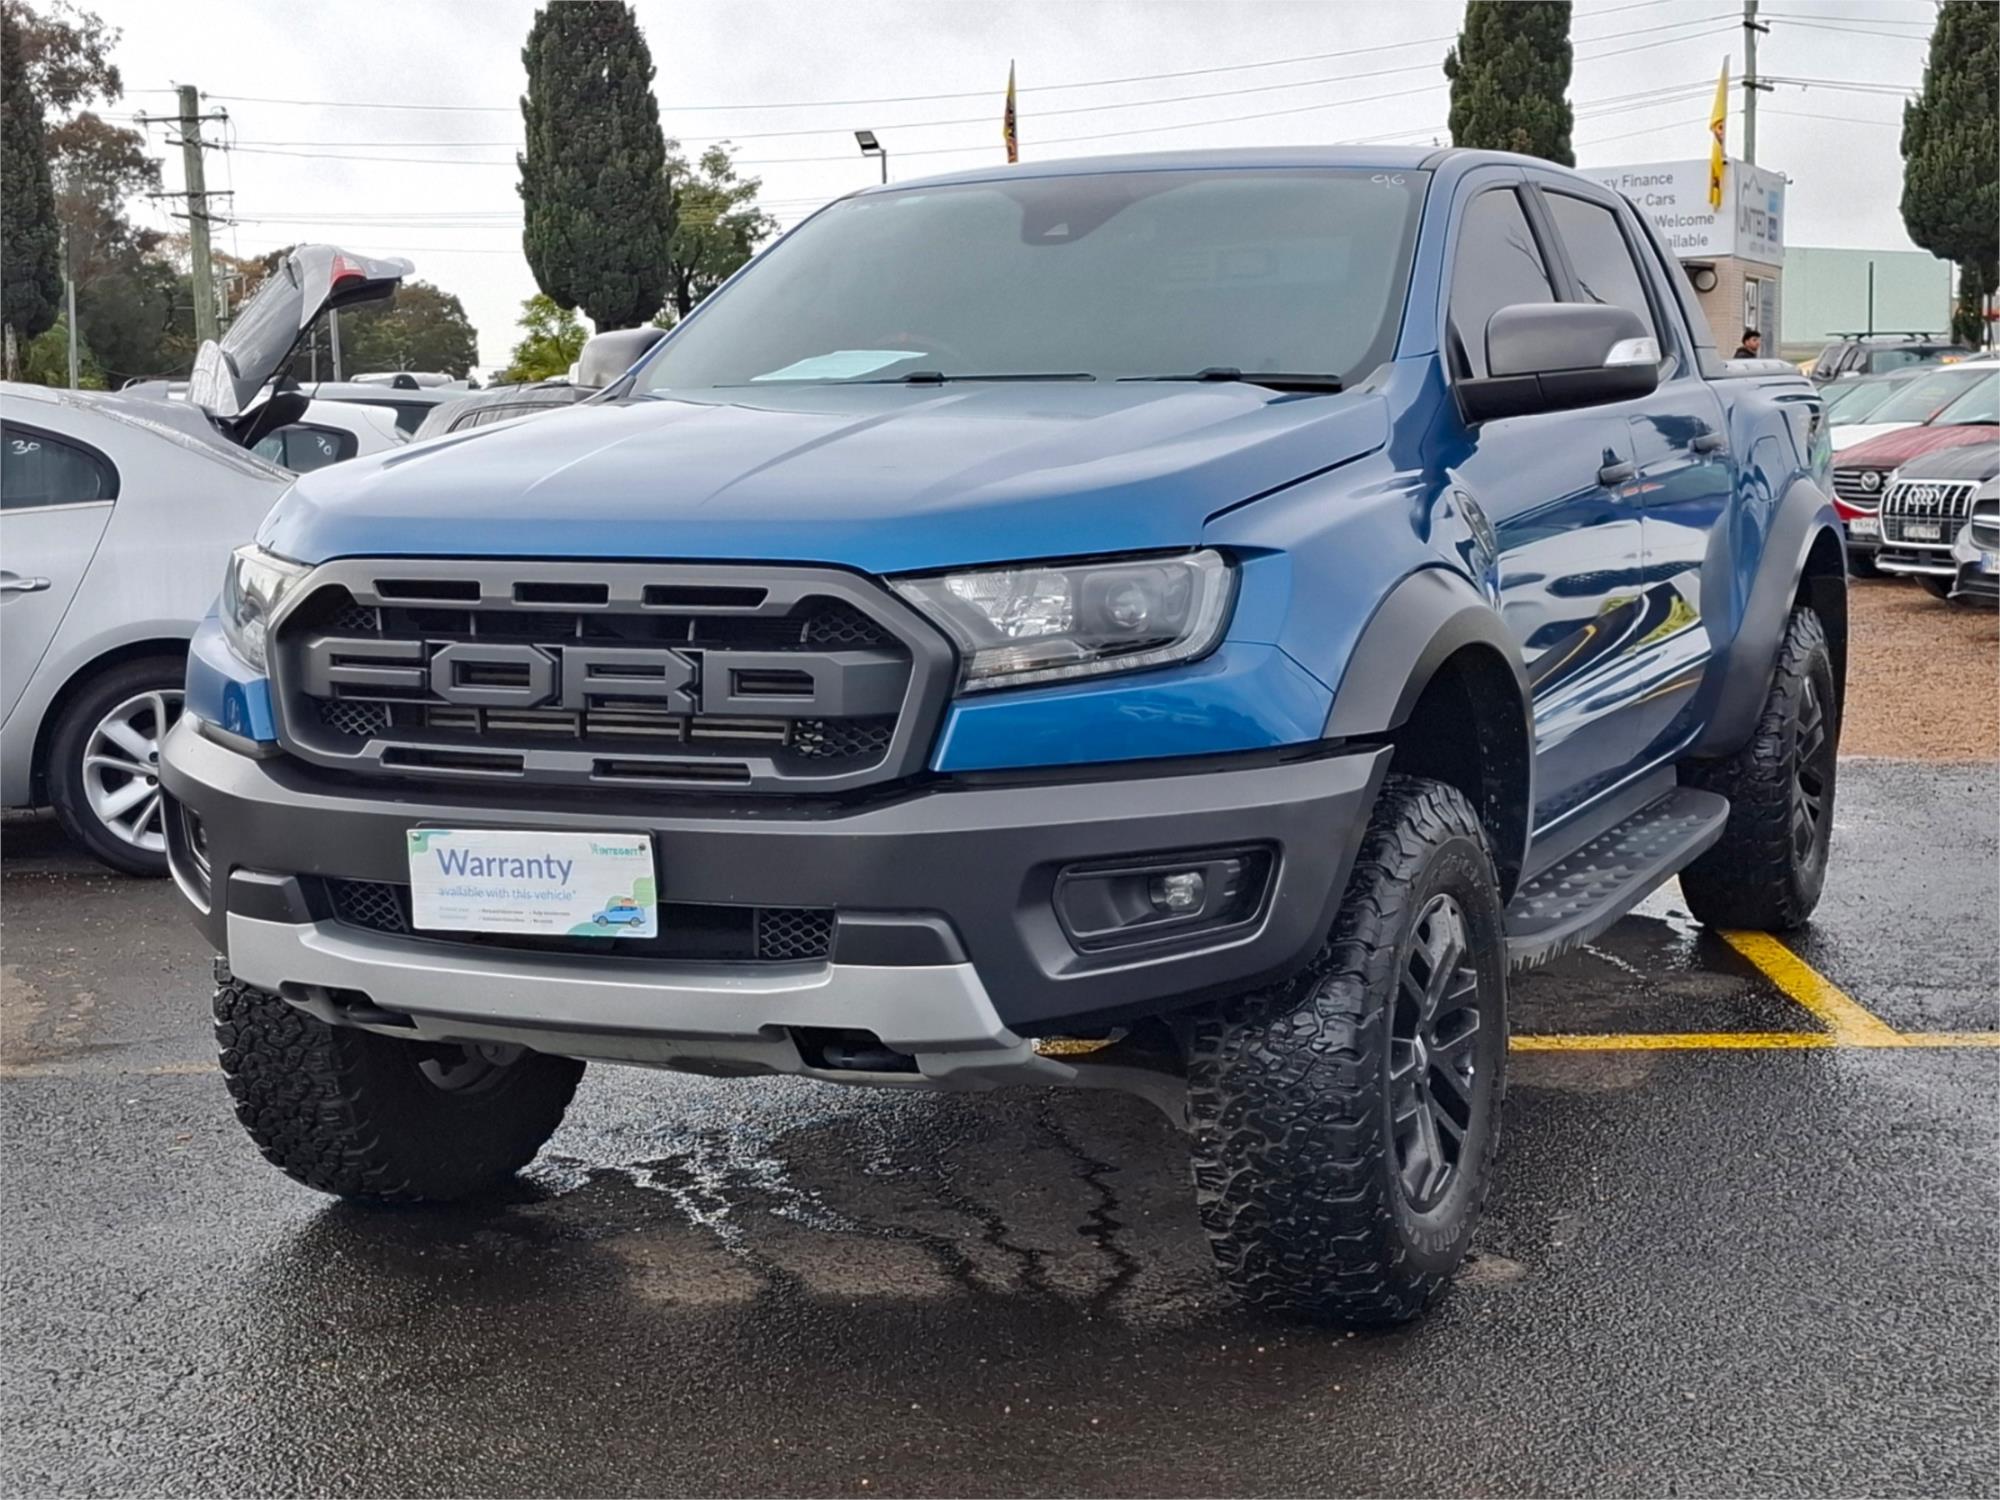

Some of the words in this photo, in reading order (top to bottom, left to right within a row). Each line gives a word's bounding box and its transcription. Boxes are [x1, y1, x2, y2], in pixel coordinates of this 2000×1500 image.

[1371, 174, 1405, 189] 96
[1601, 179, 1618, 190] sy
[1622, 174, 1673, 187] Finance
[1646, 193, 1676, 206] Cars
[1655, 214, 1715, 228] Welcome
[11, 439, 41, 455] 30
[305, 636, 865, 716] FORD
[436, 848, 573, 885] Warranty
[438, 885, 484, 898] available
[486, 886, 510, 899] with
[512, 888, 532, 900] this
